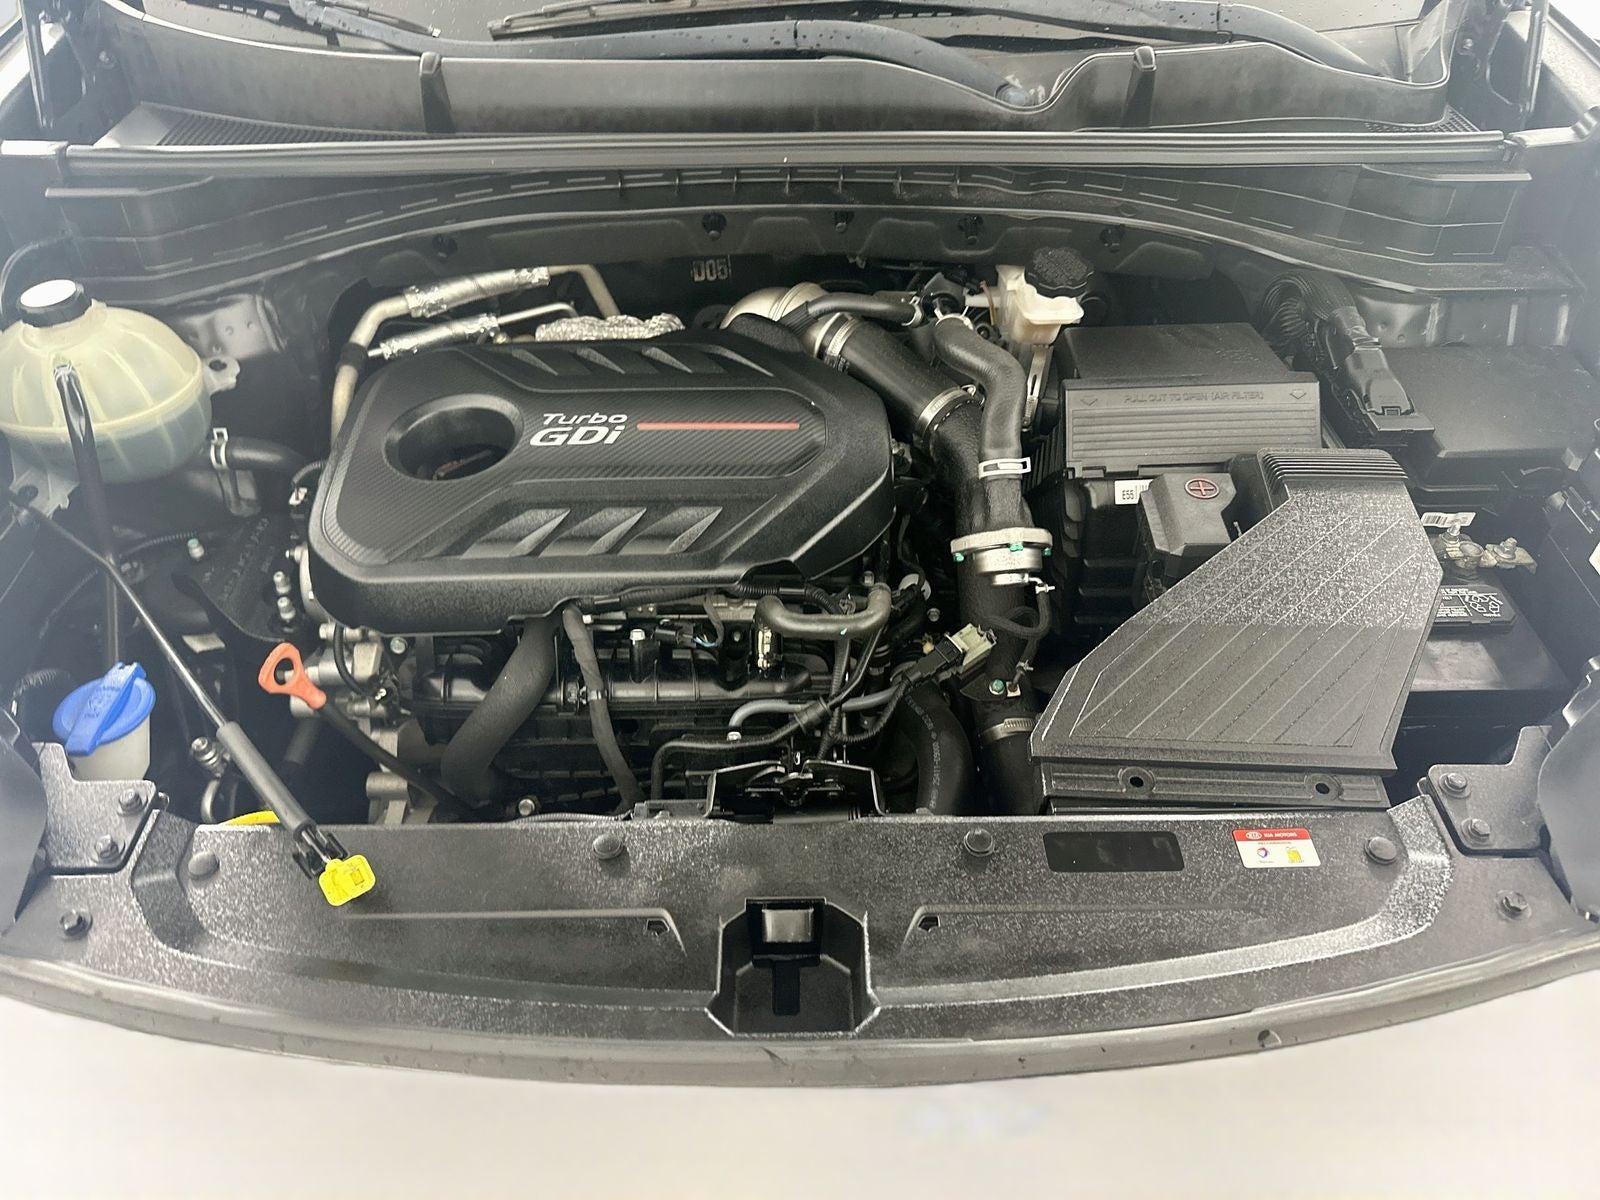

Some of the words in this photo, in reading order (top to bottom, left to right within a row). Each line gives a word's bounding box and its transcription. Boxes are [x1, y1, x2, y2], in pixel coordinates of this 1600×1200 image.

[1149, 393, 1168, 402] OUT
[543, 412, 628, 426] Turbo
[529, 425, 626, 446] GDi
